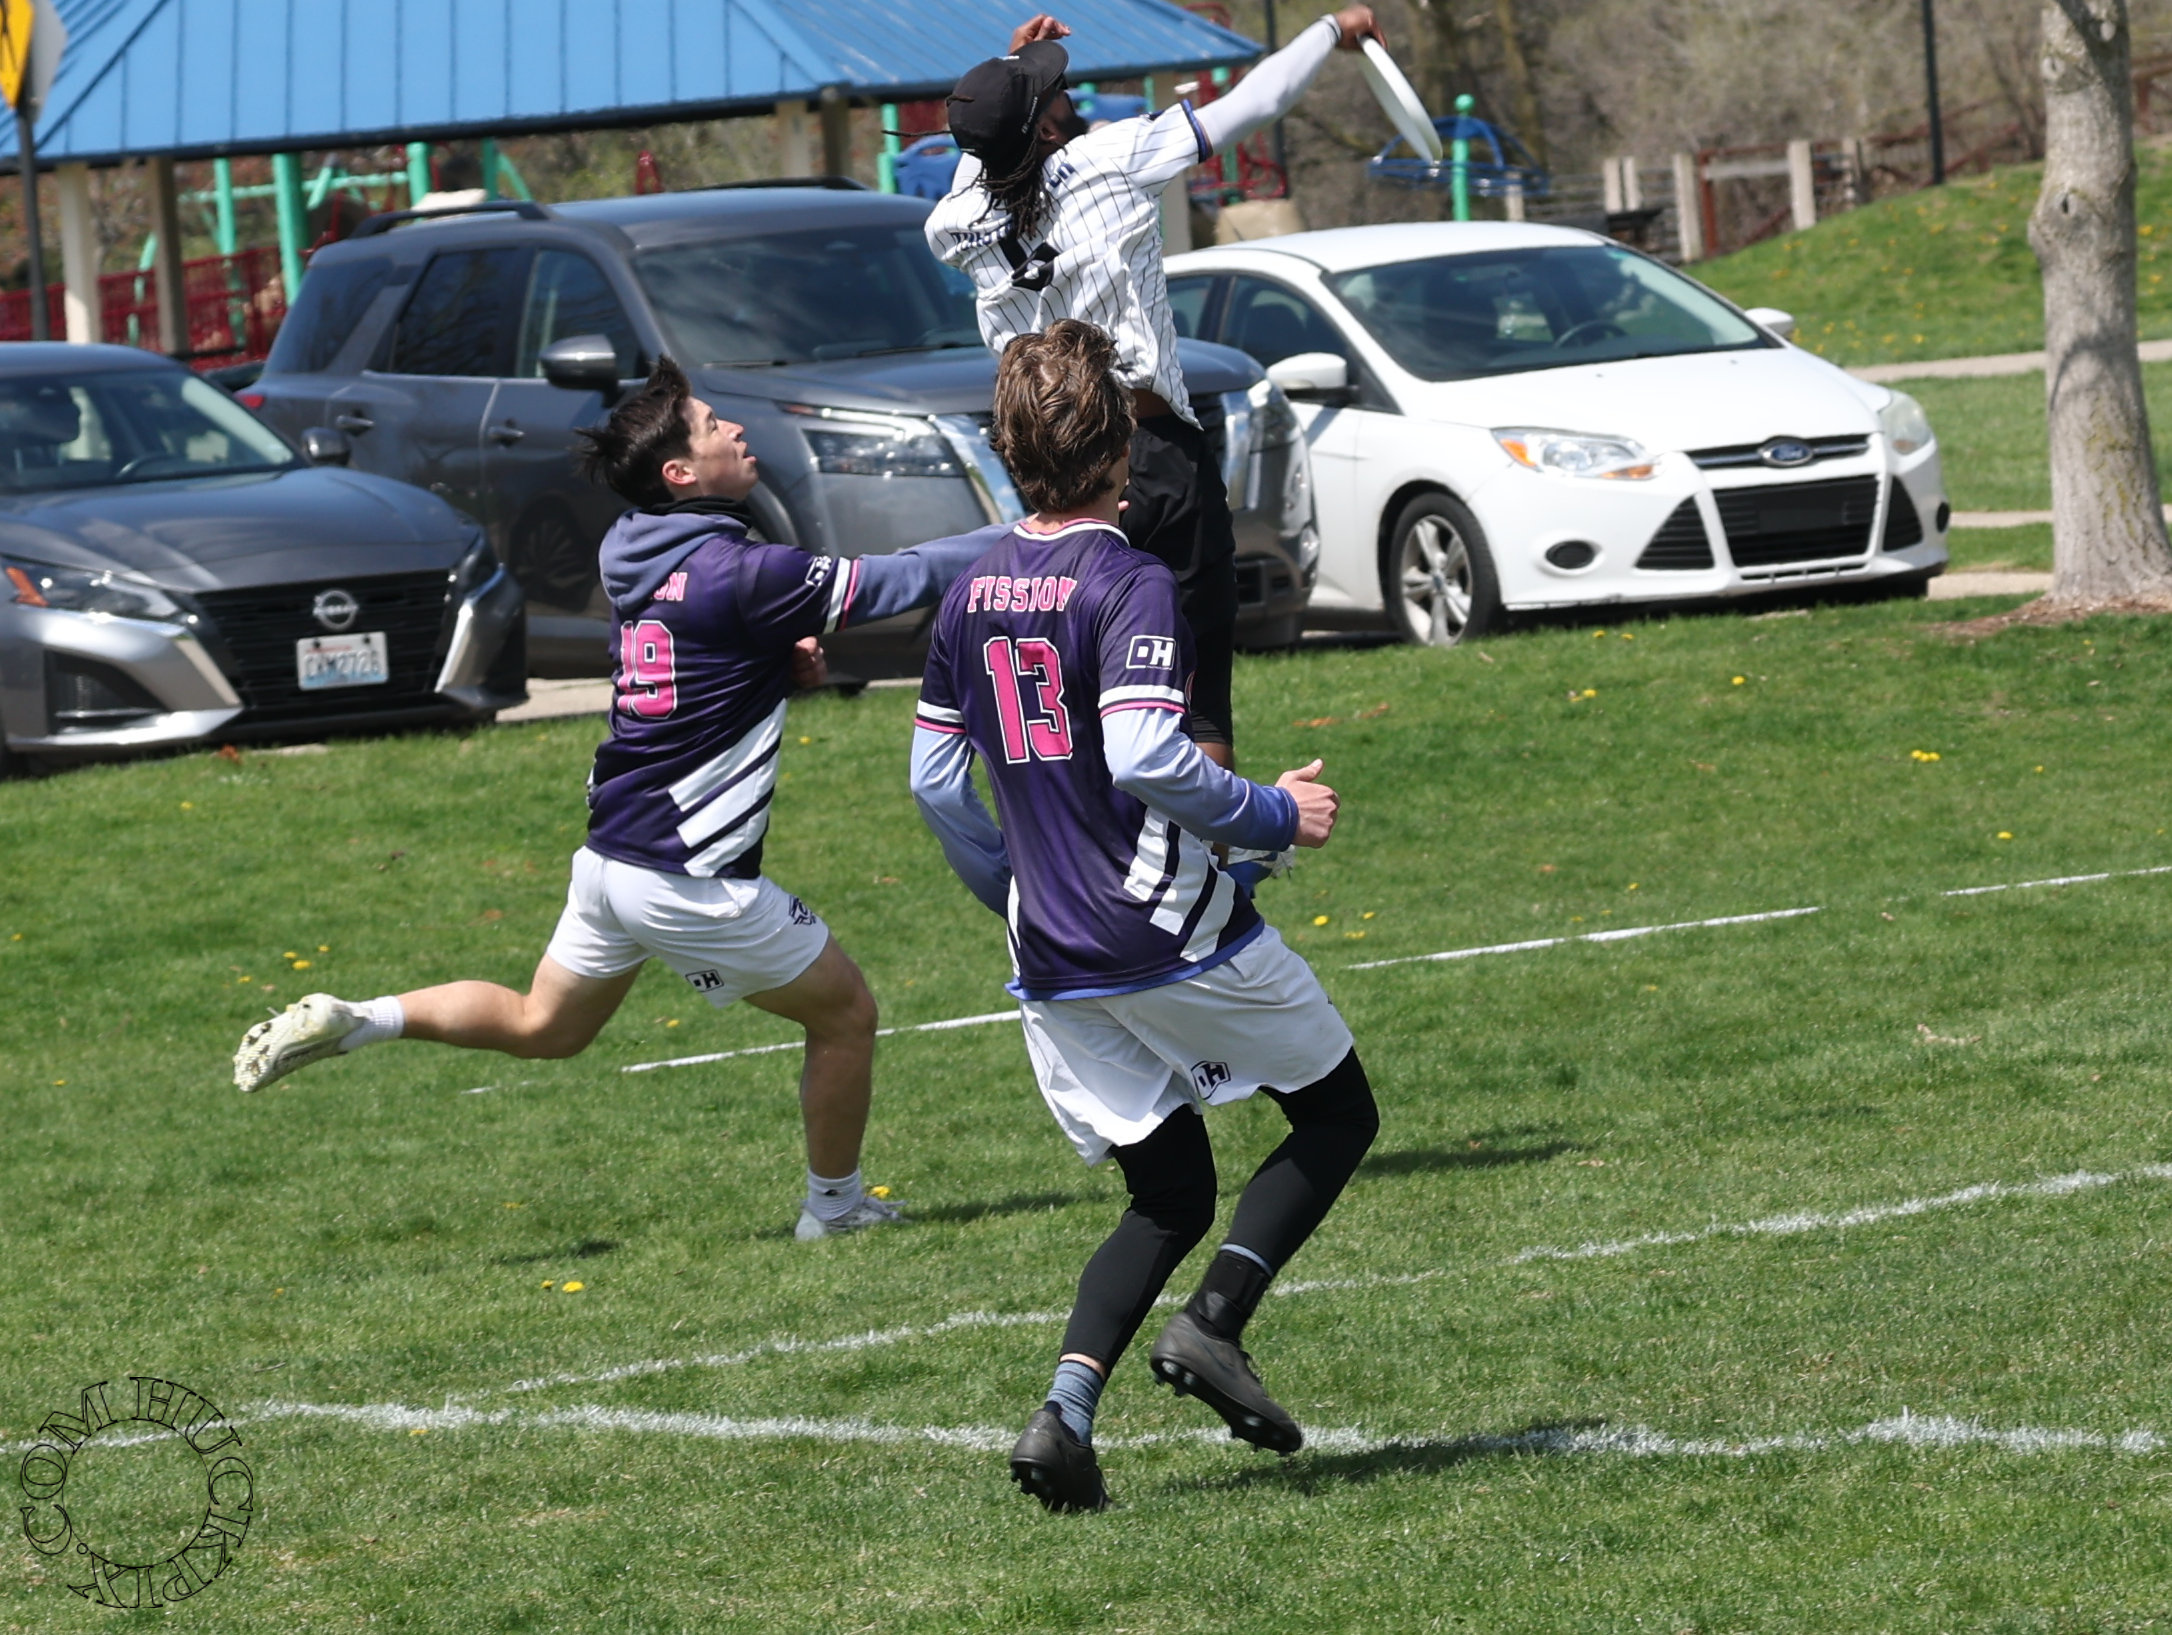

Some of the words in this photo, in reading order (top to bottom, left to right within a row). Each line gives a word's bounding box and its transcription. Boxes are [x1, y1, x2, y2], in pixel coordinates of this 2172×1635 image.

[968, 576, 1078, 613] FISSION
[617, 619, 677, 720] 19
[983, 635, 1074, 765] 13
